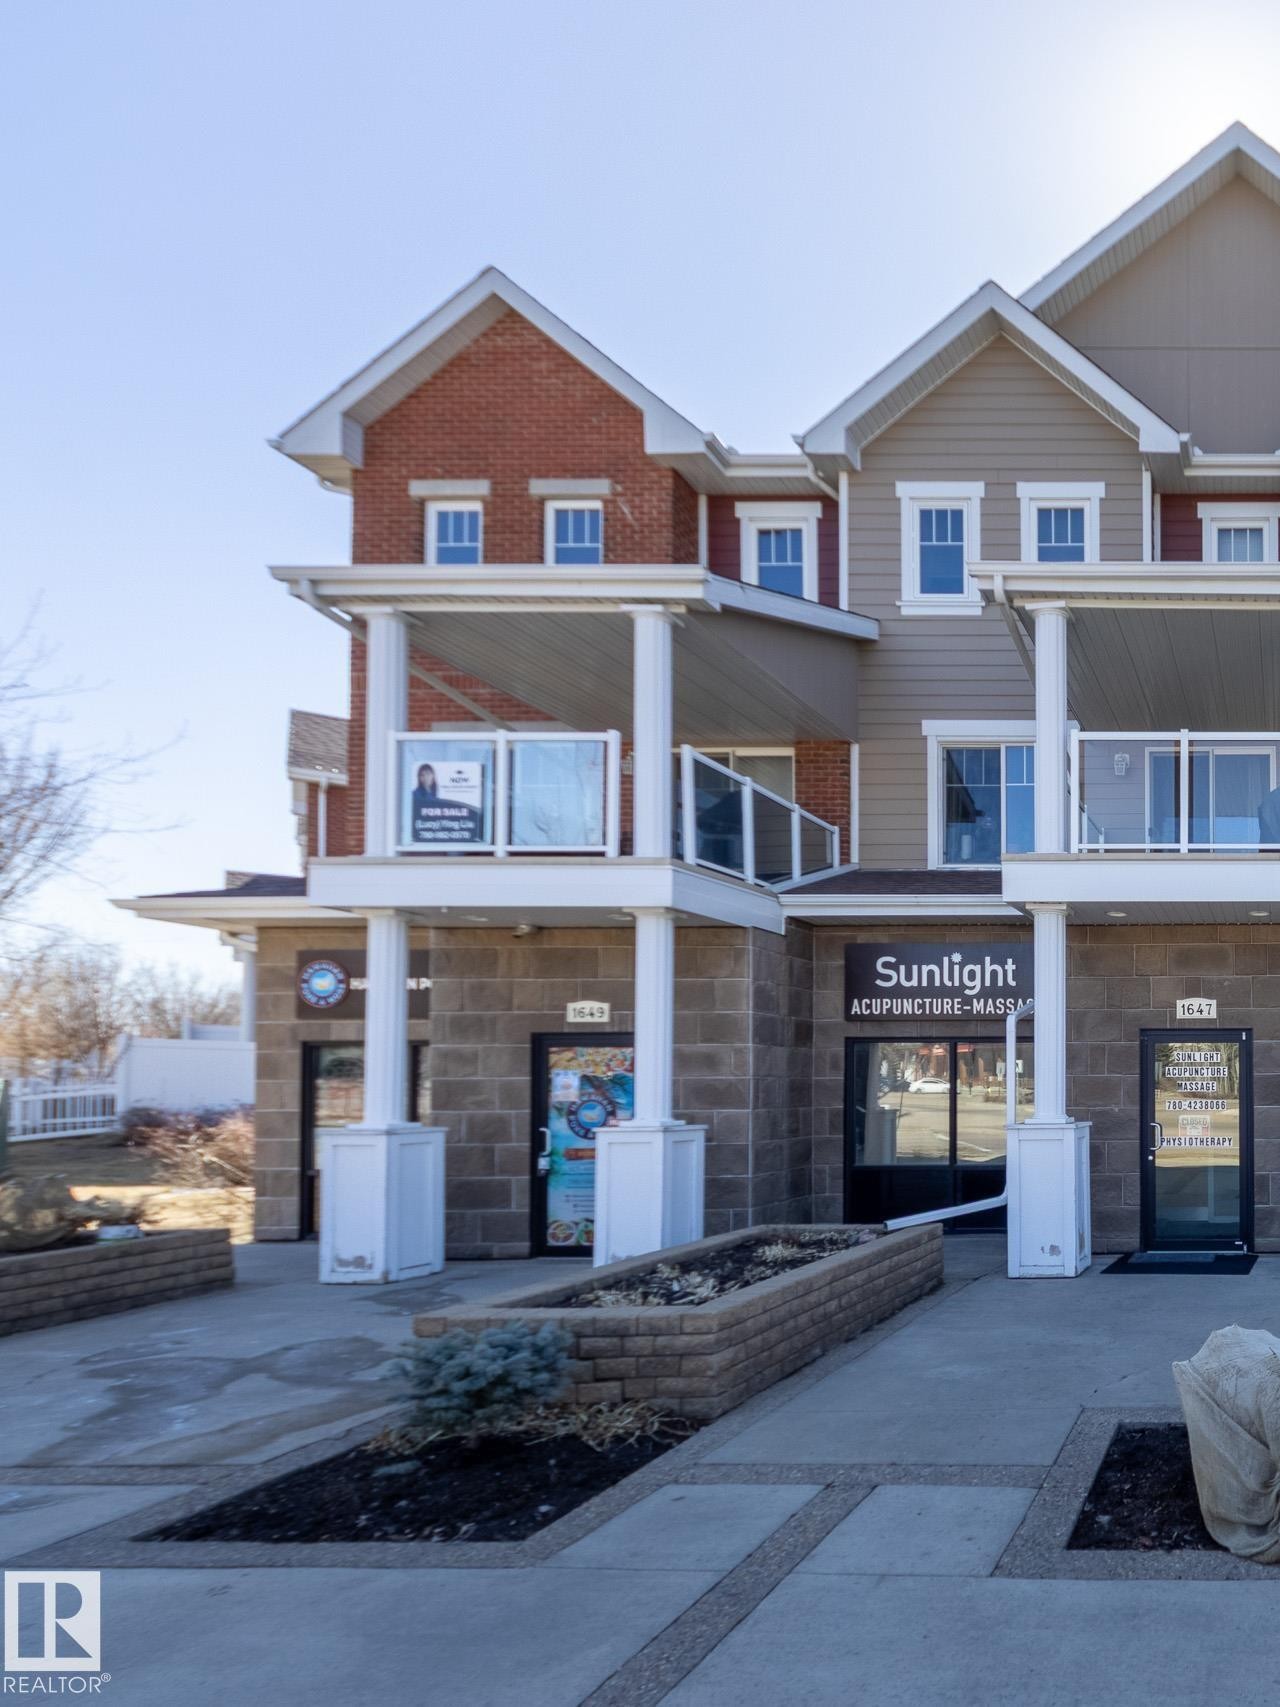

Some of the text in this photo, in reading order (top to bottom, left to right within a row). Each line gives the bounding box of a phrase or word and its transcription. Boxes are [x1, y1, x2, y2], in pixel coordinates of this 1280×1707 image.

[421, 808, 469, 816] FOR SALE
[875, 952, 1017, 995] Sunlight
[573, 1006, 605, 1018] 1649
[1181, 1003, 1213, 1016] 1647
[1176, 1053, 1220, 1062] SUNLIGHT
[1166, 1067, 1227, 1077] ACUPUNCTURE
[1177, 1082, 1216, 1091] MASSAGE
[1167, 1100, 1226, 1109] 780-4238066
[1161, 1137, 1233, 1146] PHYSIOTHERAPY
